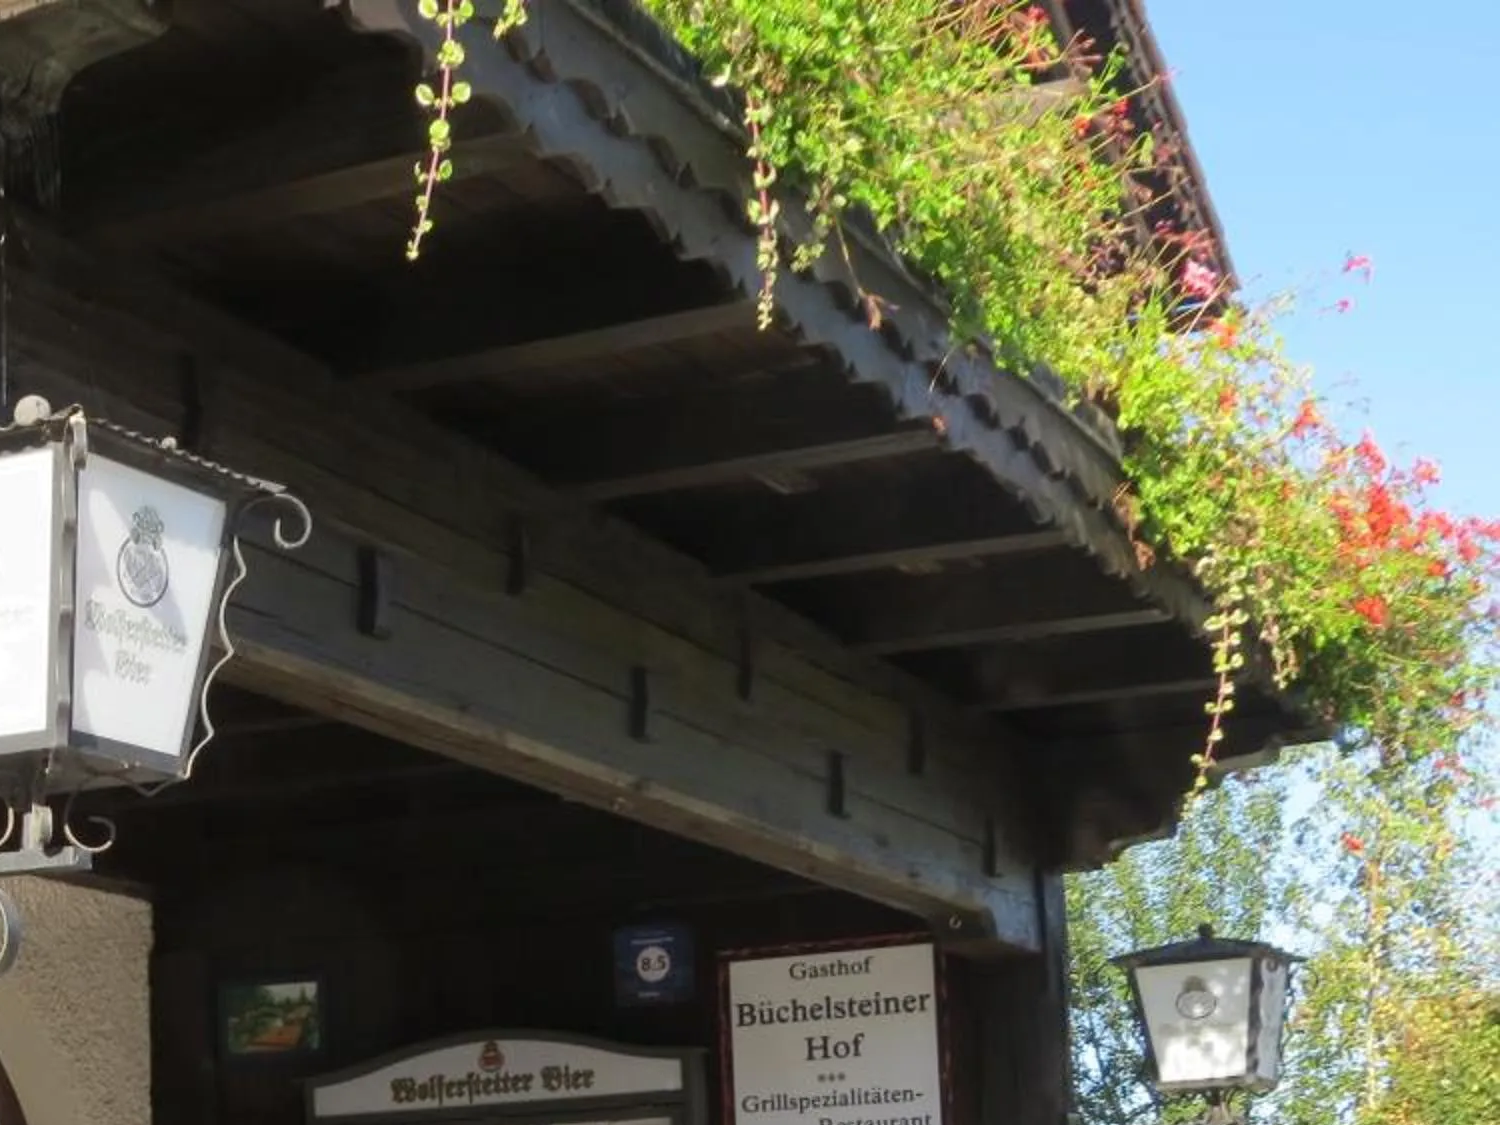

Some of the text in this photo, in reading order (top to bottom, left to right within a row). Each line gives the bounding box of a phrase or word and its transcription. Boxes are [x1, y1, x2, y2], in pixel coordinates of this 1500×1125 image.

[789, 956, 874, 980] Gasthof
[736, 991, 931, 1027] Büchelsteiner
[804, 1032, 865, 1061] Hof
[540, 1063, 595, 1092] Bier
[741, 1087, 924, 1114] Grillspezialitäten-
